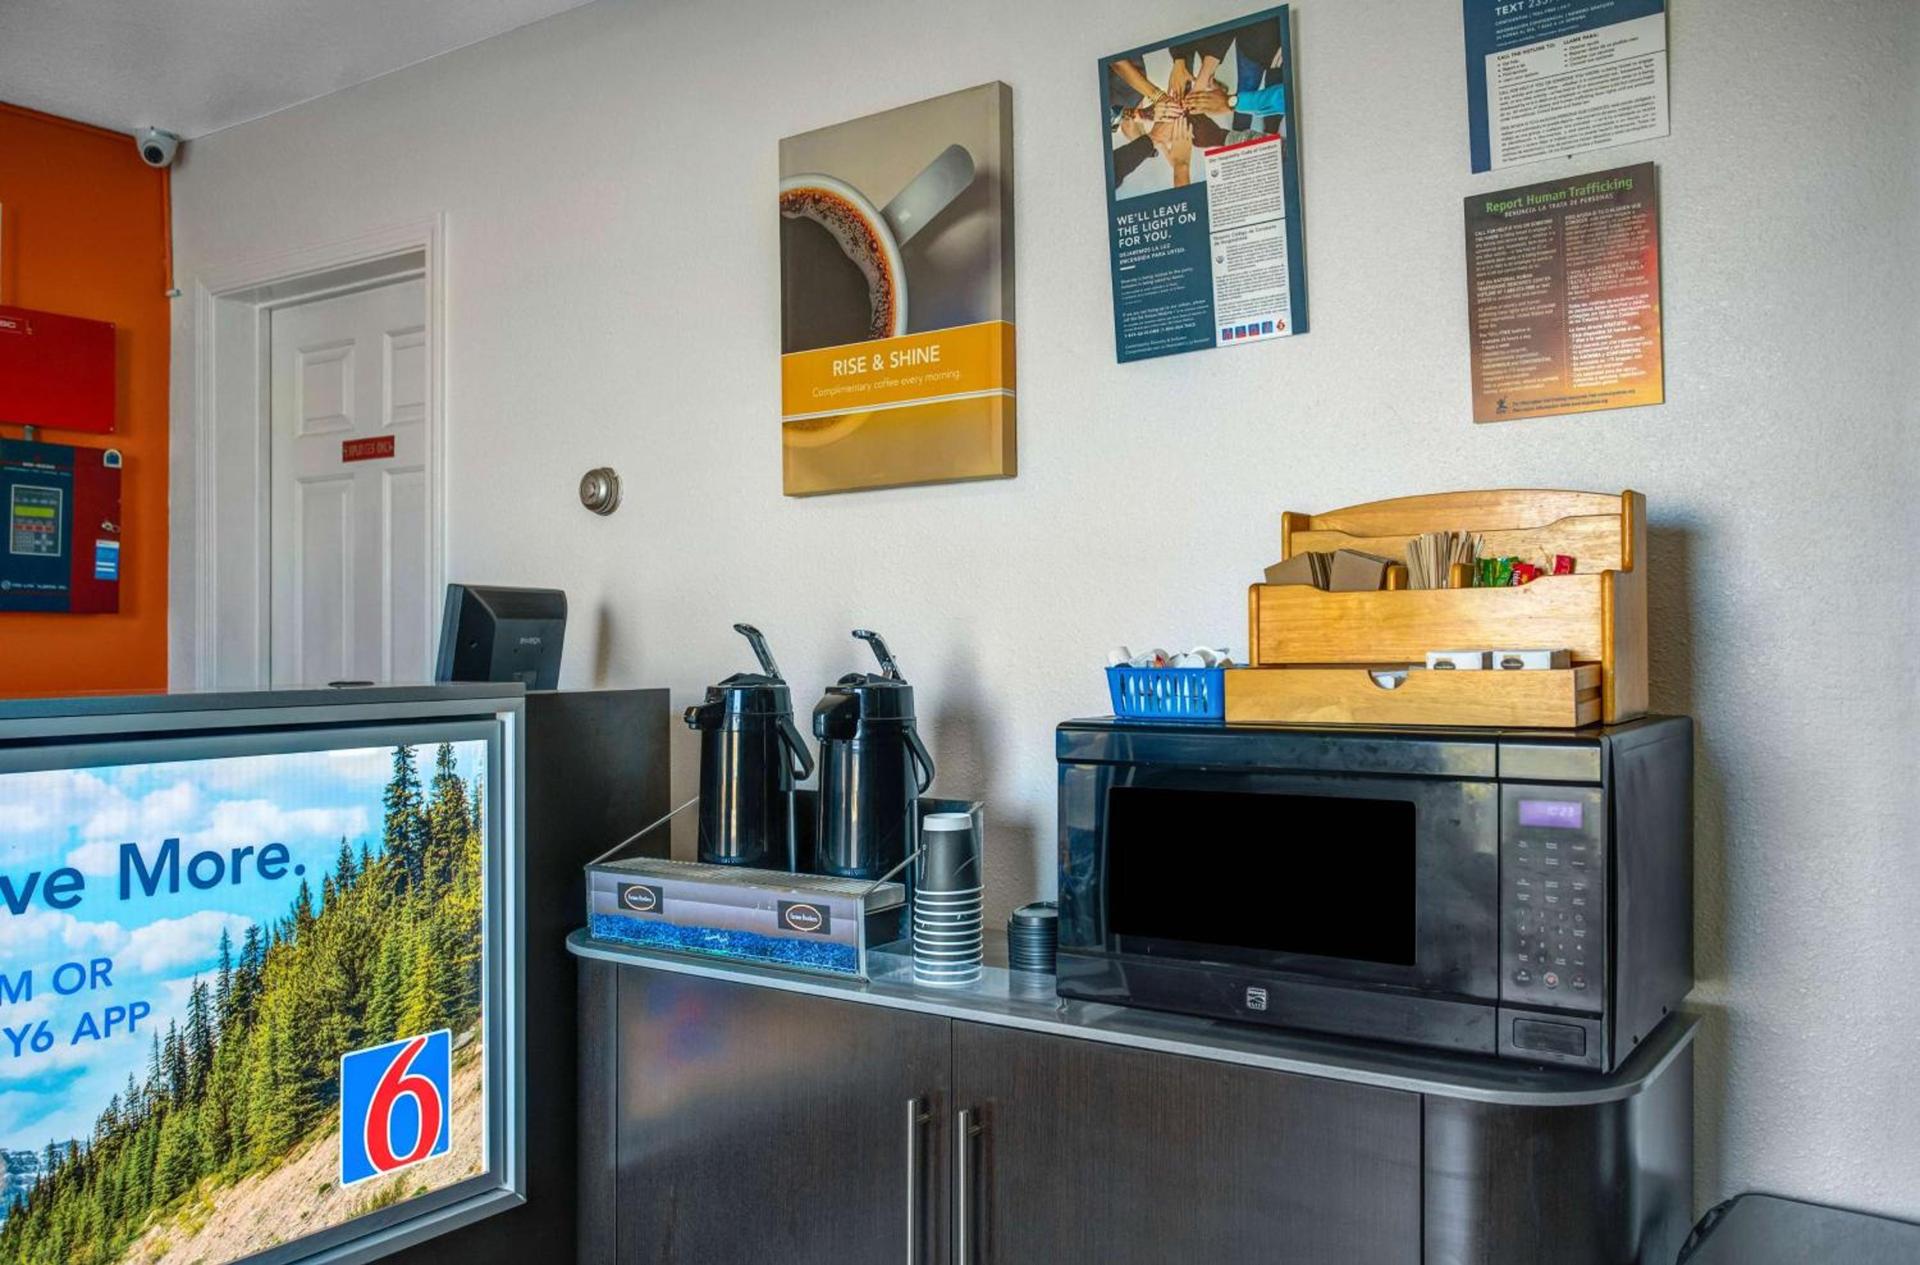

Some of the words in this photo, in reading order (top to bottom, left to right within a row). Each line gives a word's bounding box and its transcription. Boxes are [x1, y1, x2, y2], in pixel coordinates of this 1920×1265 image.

[1495, 1, 1524, 16] TEXT
[1486, 197, 1523, 213] Report
[1526, 190, 1566, 206] Human
[1568, 178, 1633, 198] Trafficking
[1116, 211, 1150, 226] WE'LL
[1152, 202, 1188, 219] LEAVE
[1117, 224, 1139, 237] THE
[1142, 216, 1174, 232] LIGHT
[1178, 212, 1197, 224] ON
[1118, 235, 1141, 248] FOR
[1143, 229, 1172, 243] YOU.
[1277, 319, 1286, 331] 6
[832, 356, 867, 377] RISE
[872, 353, 884, 371] &
[890, 344, 940, 369] SHINE
[812, 382, 872, 398] Complimentary
[874, 376, 900, 390] coffee
[900, 373, 923, 387] every
[119, 838, 306, 901] More.
[52, 957, 113, 996] OR
[3, 1020, 54, 1058] Y6
[71, 1001, 151, 1046] APP
[364, 1036, 443, 1175] 6
